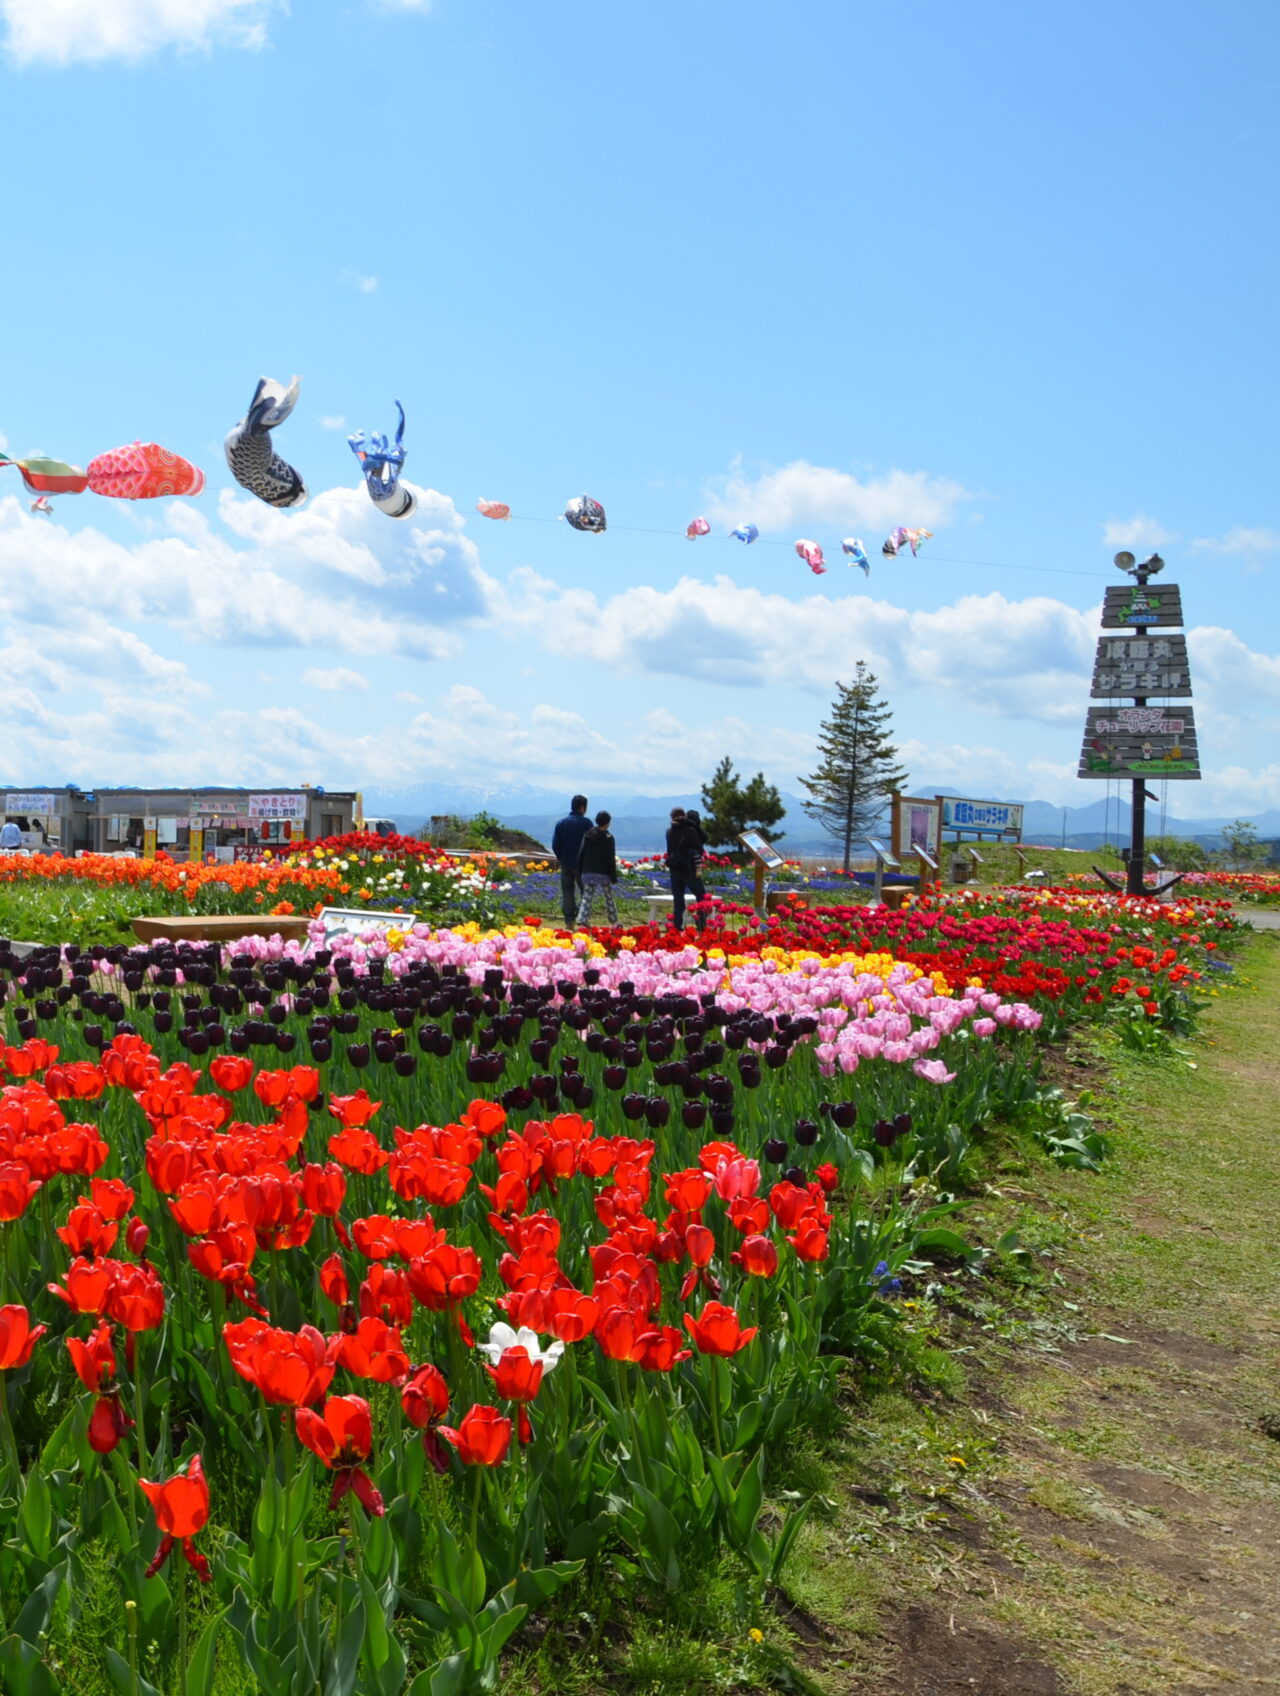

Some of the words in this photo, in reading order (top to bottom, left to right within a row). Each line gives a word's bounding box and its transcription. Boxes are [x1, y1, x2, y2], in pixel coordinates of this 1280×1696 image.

[1098, 673, 1181, 690] サラキ岬
[1118, 709, 1164, 721] オランダ
[1096, 720, 1184, 733] チューリップ花園
[261, 797, 295, 807] やきとり
